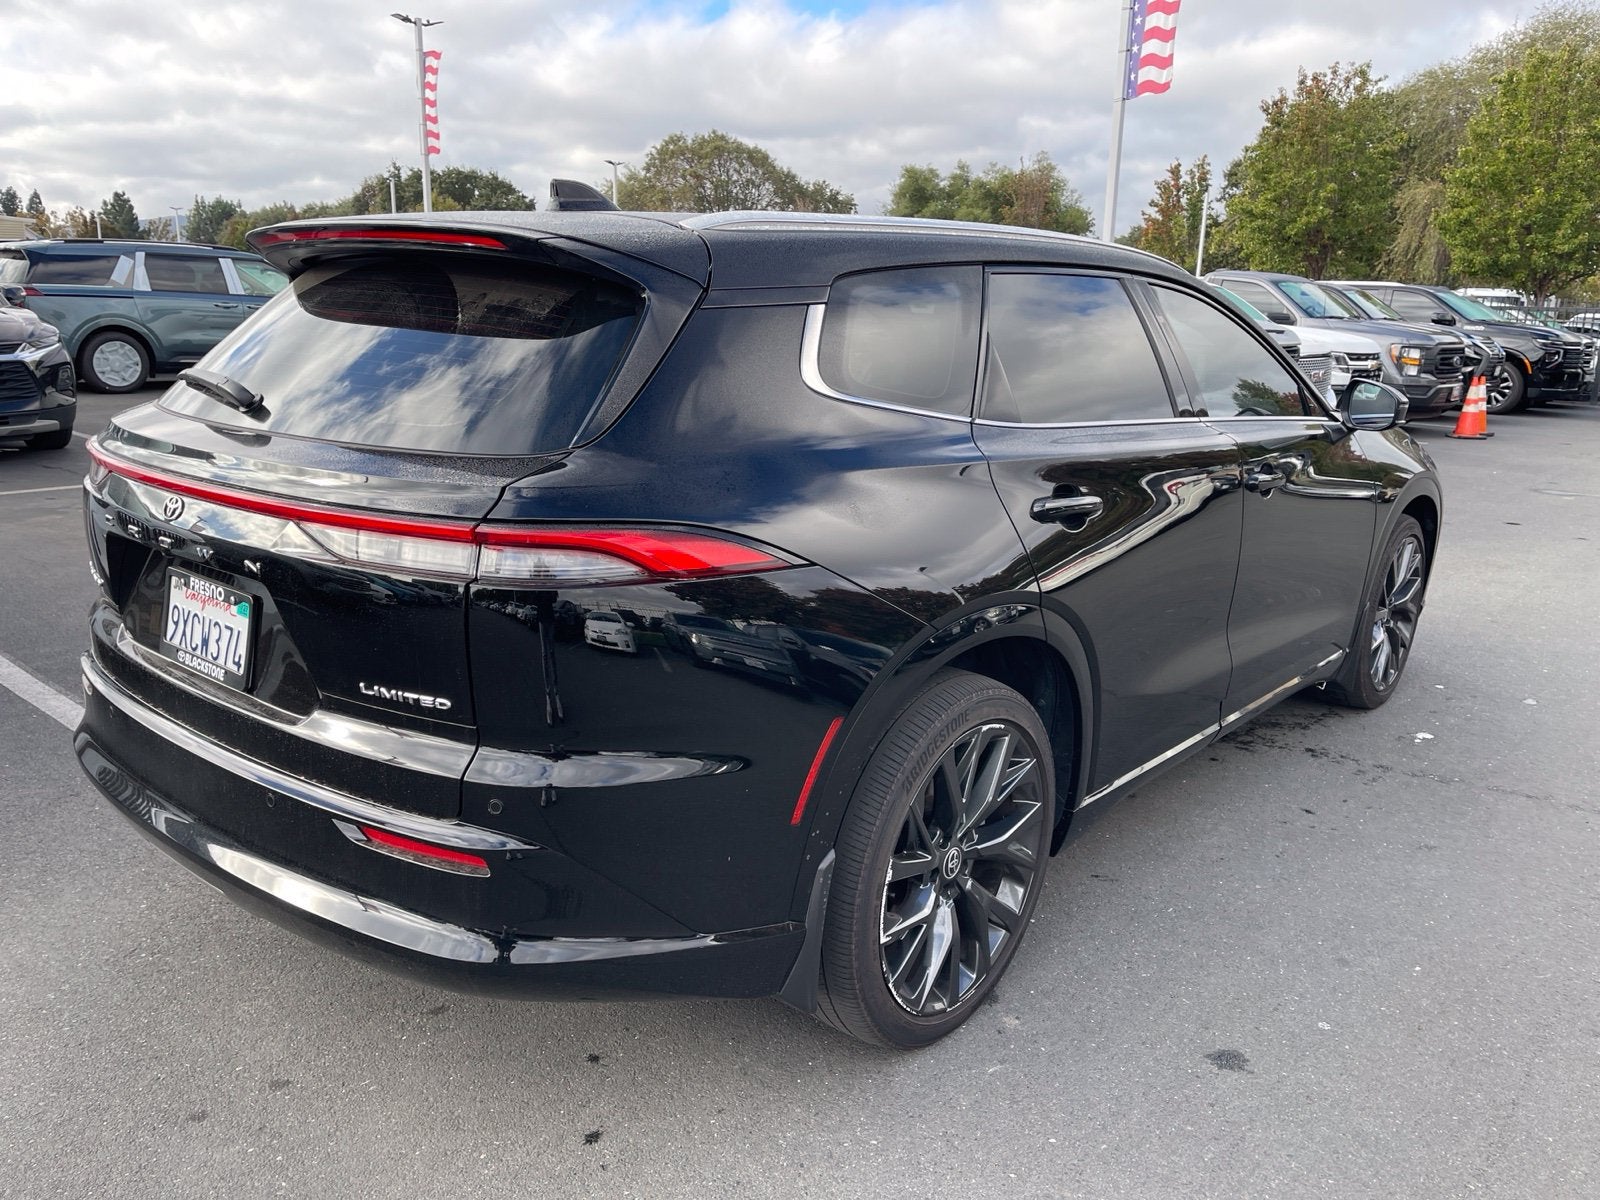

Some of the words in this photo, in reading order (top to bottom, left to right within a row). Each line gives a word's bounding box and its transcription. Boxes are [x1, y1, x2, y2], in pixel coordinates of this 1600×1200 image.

[105, 514, 260, 575] CROWN
[190, 577, 225, 601] FRESNO
[169, 604, 242, 672] 9XCW374
[184, 653, 226, 681] BLACKSTONE
[359, 682, 452, 710] LIMITED
[903, 709, 971, 794] BRIDGESTONE
